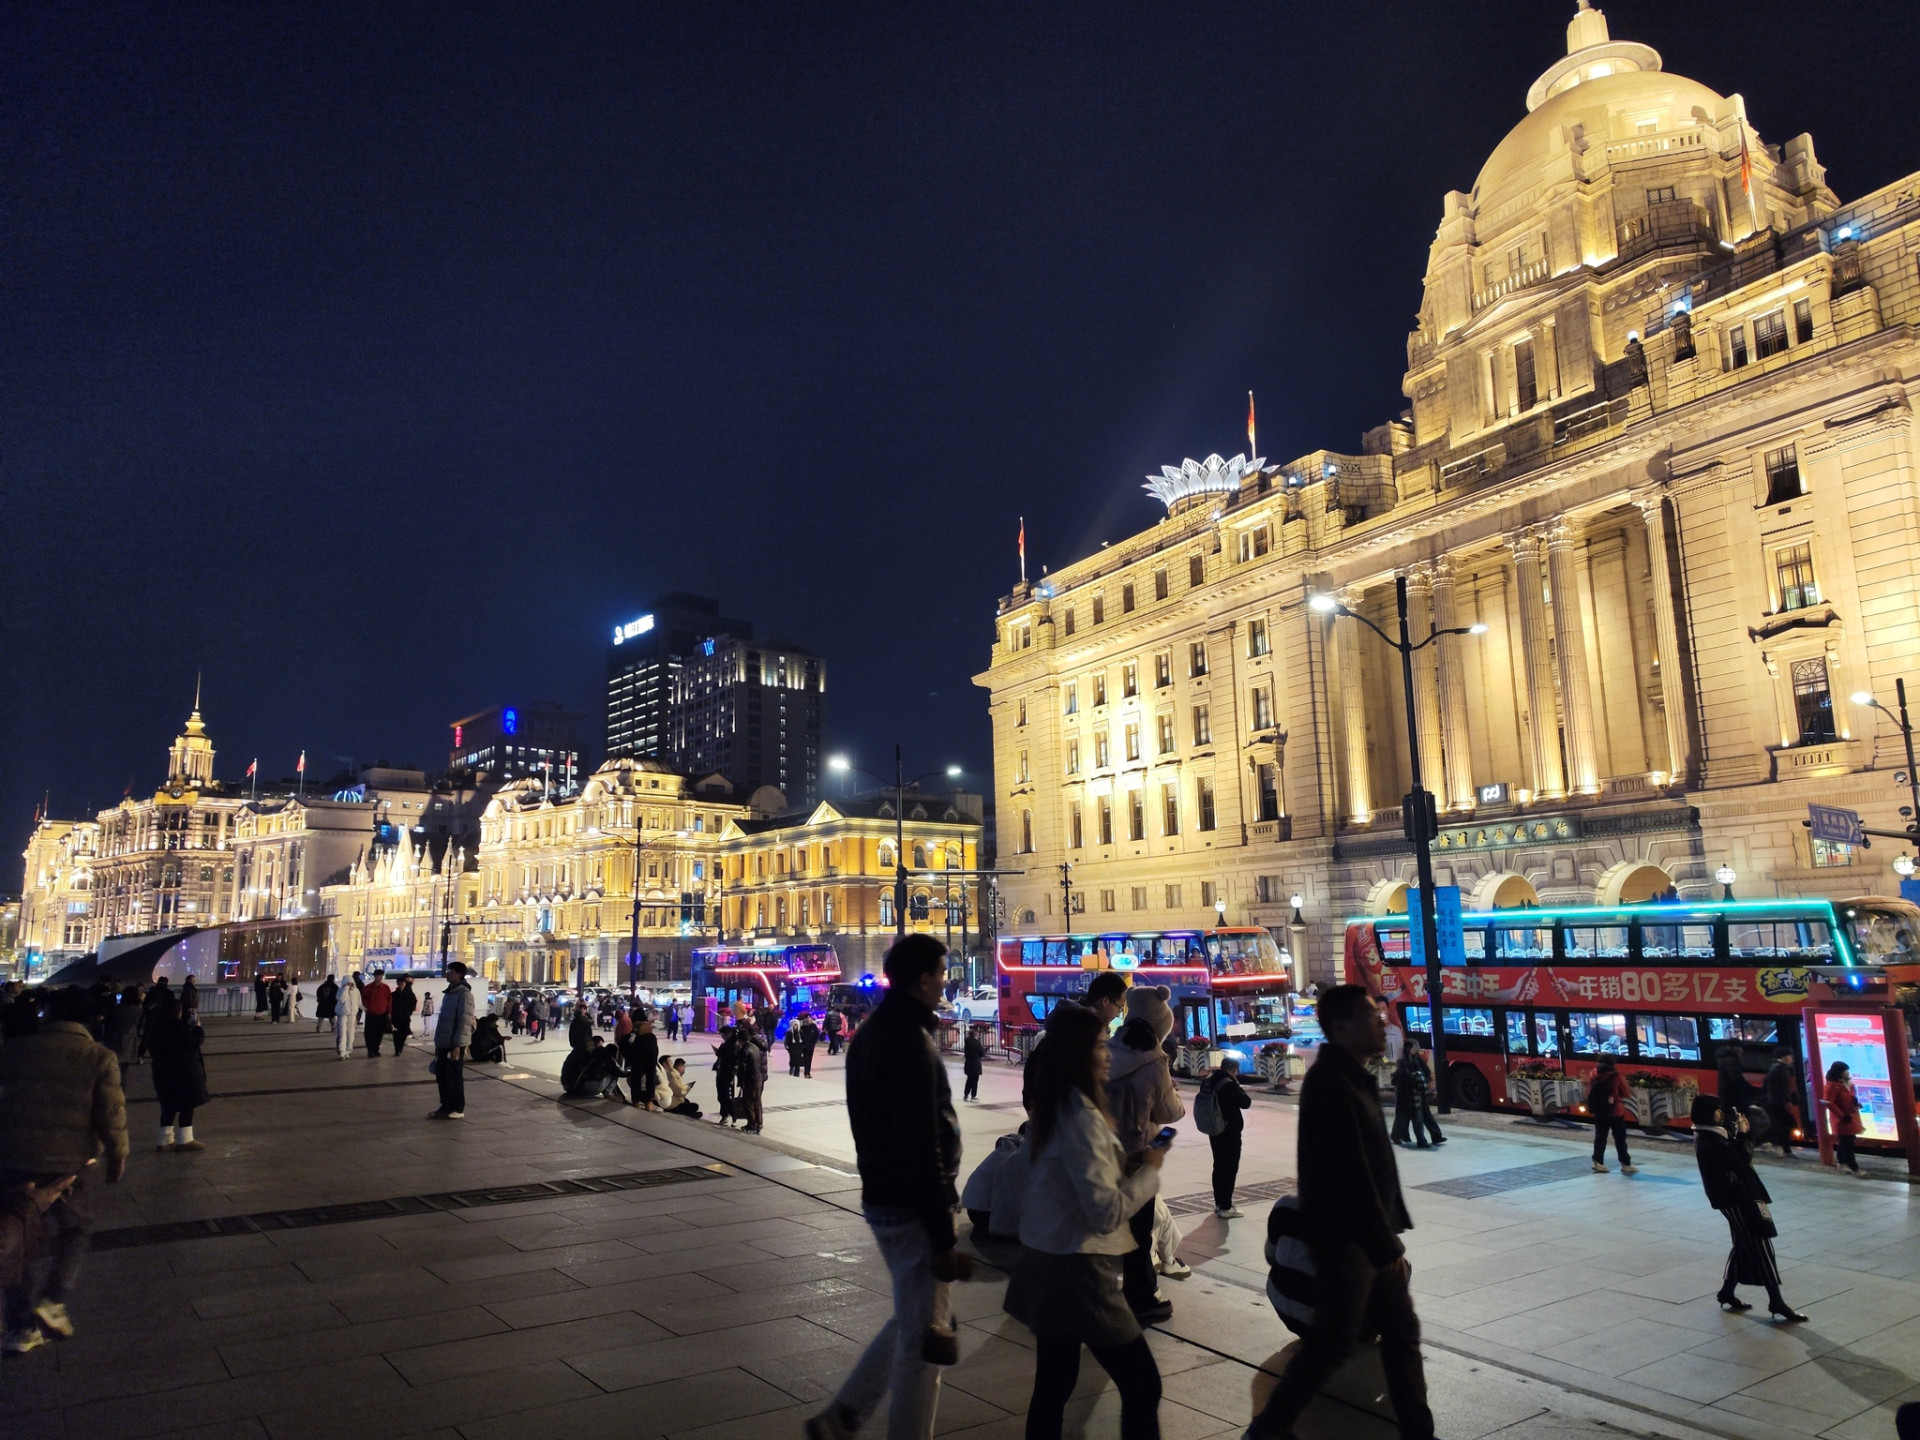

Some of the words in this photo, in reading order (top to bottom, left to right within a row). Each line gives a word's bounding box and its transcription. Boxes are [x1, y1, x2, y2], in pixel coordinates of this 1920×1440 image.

[1578, 971, 1748, 1003] 年销80多亿支
